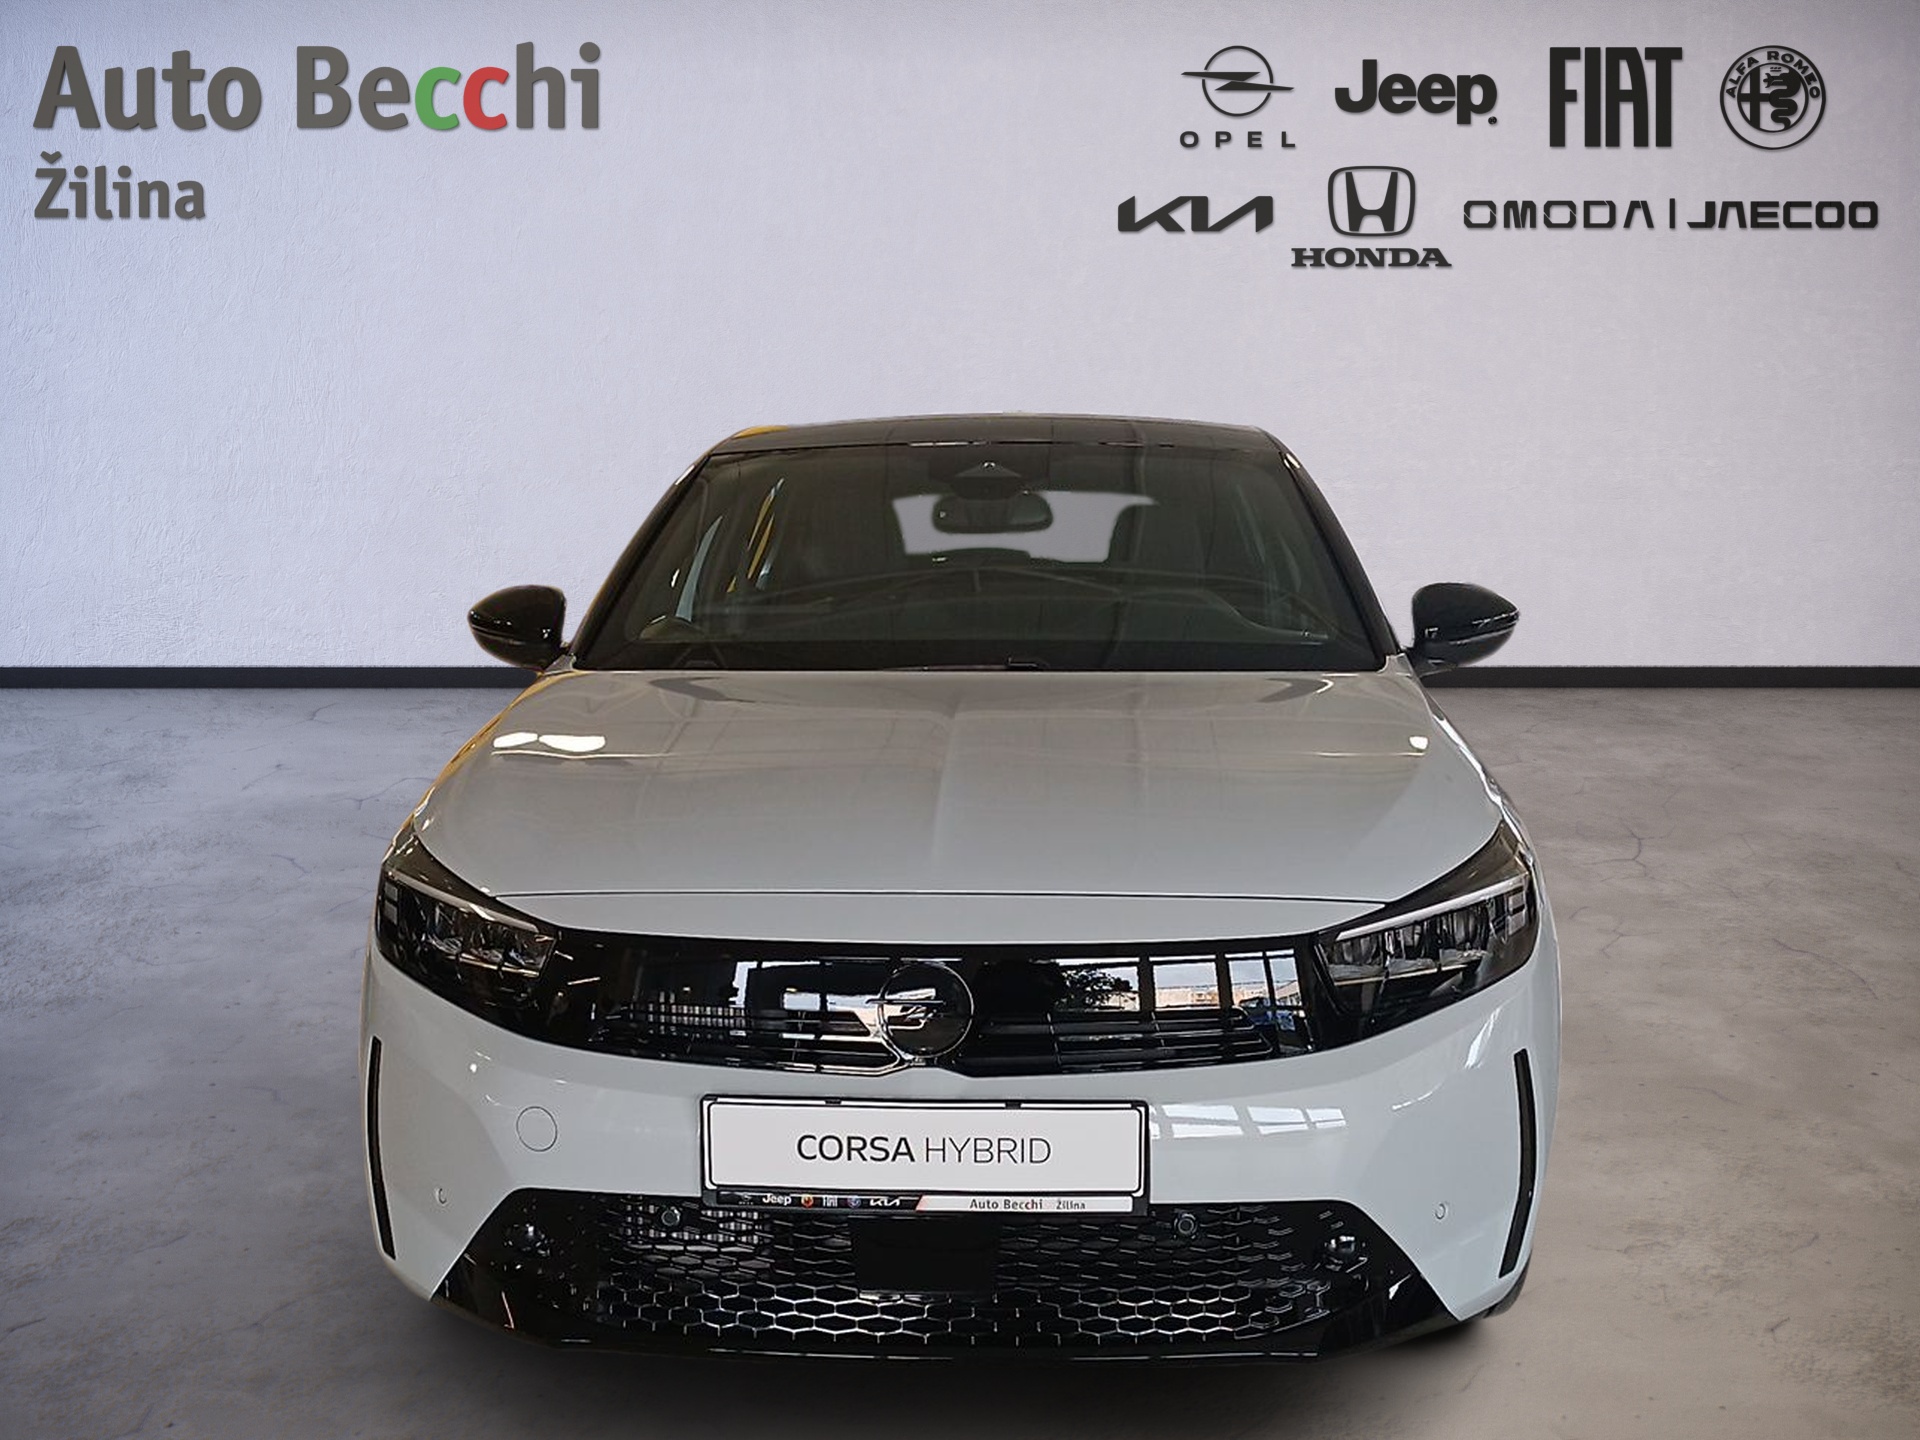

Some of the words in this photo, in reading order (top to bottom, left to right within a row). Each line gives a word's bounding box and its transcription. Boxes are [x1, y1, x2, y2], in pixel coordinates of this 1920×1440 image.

[33, 46, 261, 129] Auto
[297, 42, 600, 129] Becchi
[1726, 56, 1759, 98] ALFA
[1766, 50, 1820, 98] ROMEO
[1335, 59, 1497, 125] Jeep
[1549, 47, 1683, 147] FIAT
[1180, 131, 1296, 148] OPEL
[34, 151, 205, 218] Žilina
[1118, 196, 1273, 232] KIA
[1463, 200, 1654, 228] OMODA
[1686, 200, 1879, 229] JAECOO
[1291, 247, 1452, 267] HONDA
[797, 1135, 915, 1162] CORSA
[925, 1137, 1052, 1164] HYBRID
[762, 1193, 792, 1206] Jeep
[970, 1199, 999, 1210] Auto
[1003, 1199, 1043, 1210] Becchi
